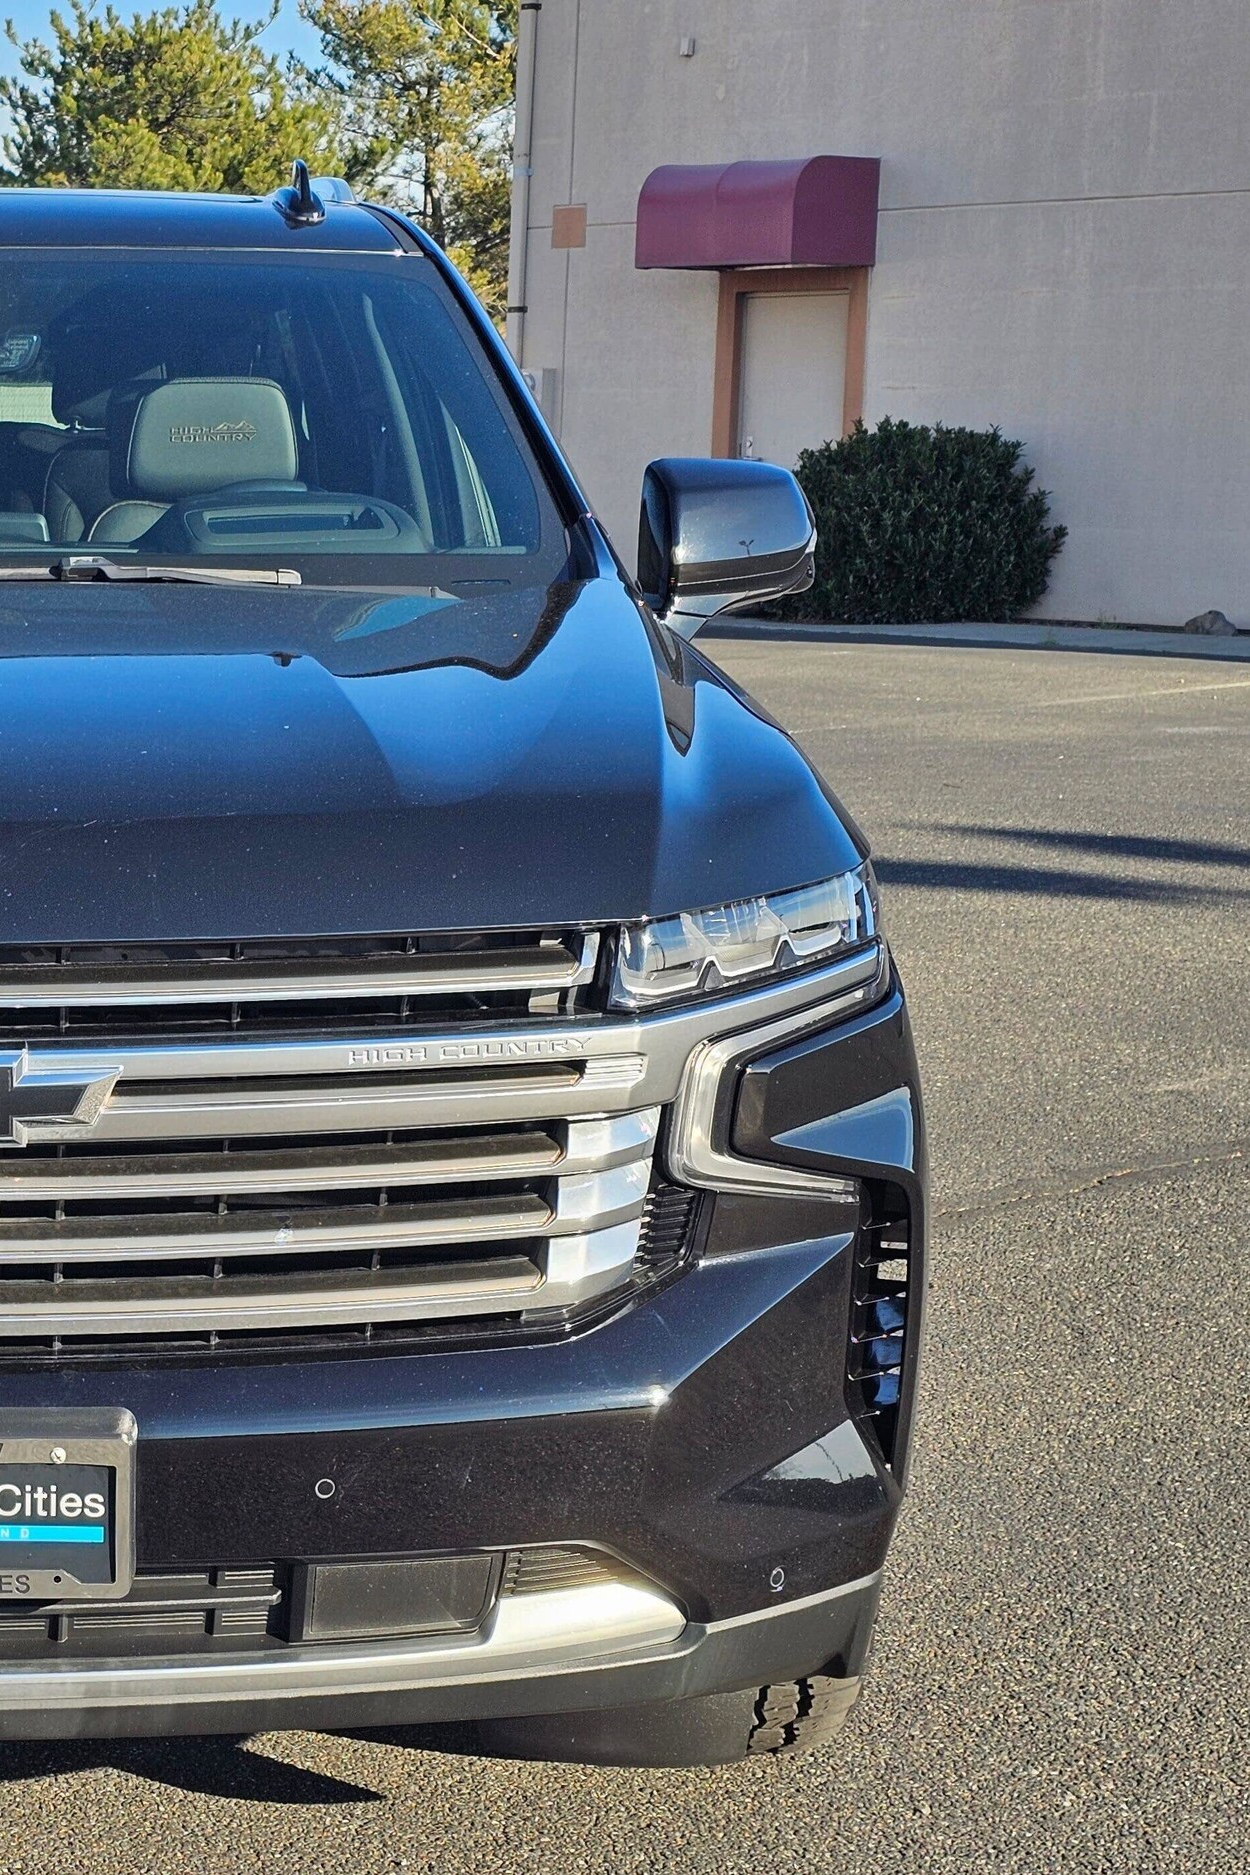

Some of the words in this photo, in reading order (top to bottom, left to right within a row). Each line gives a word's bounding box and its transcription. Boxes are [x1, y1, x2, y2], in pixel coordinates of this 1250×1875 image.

[170, 426, 214, 434] HIGH
[170, 433, 257, 443] COUNTRY
[348, 1046, 427, 1065] HIGH
[439, 1037, 592, 1060] COUNTRY
